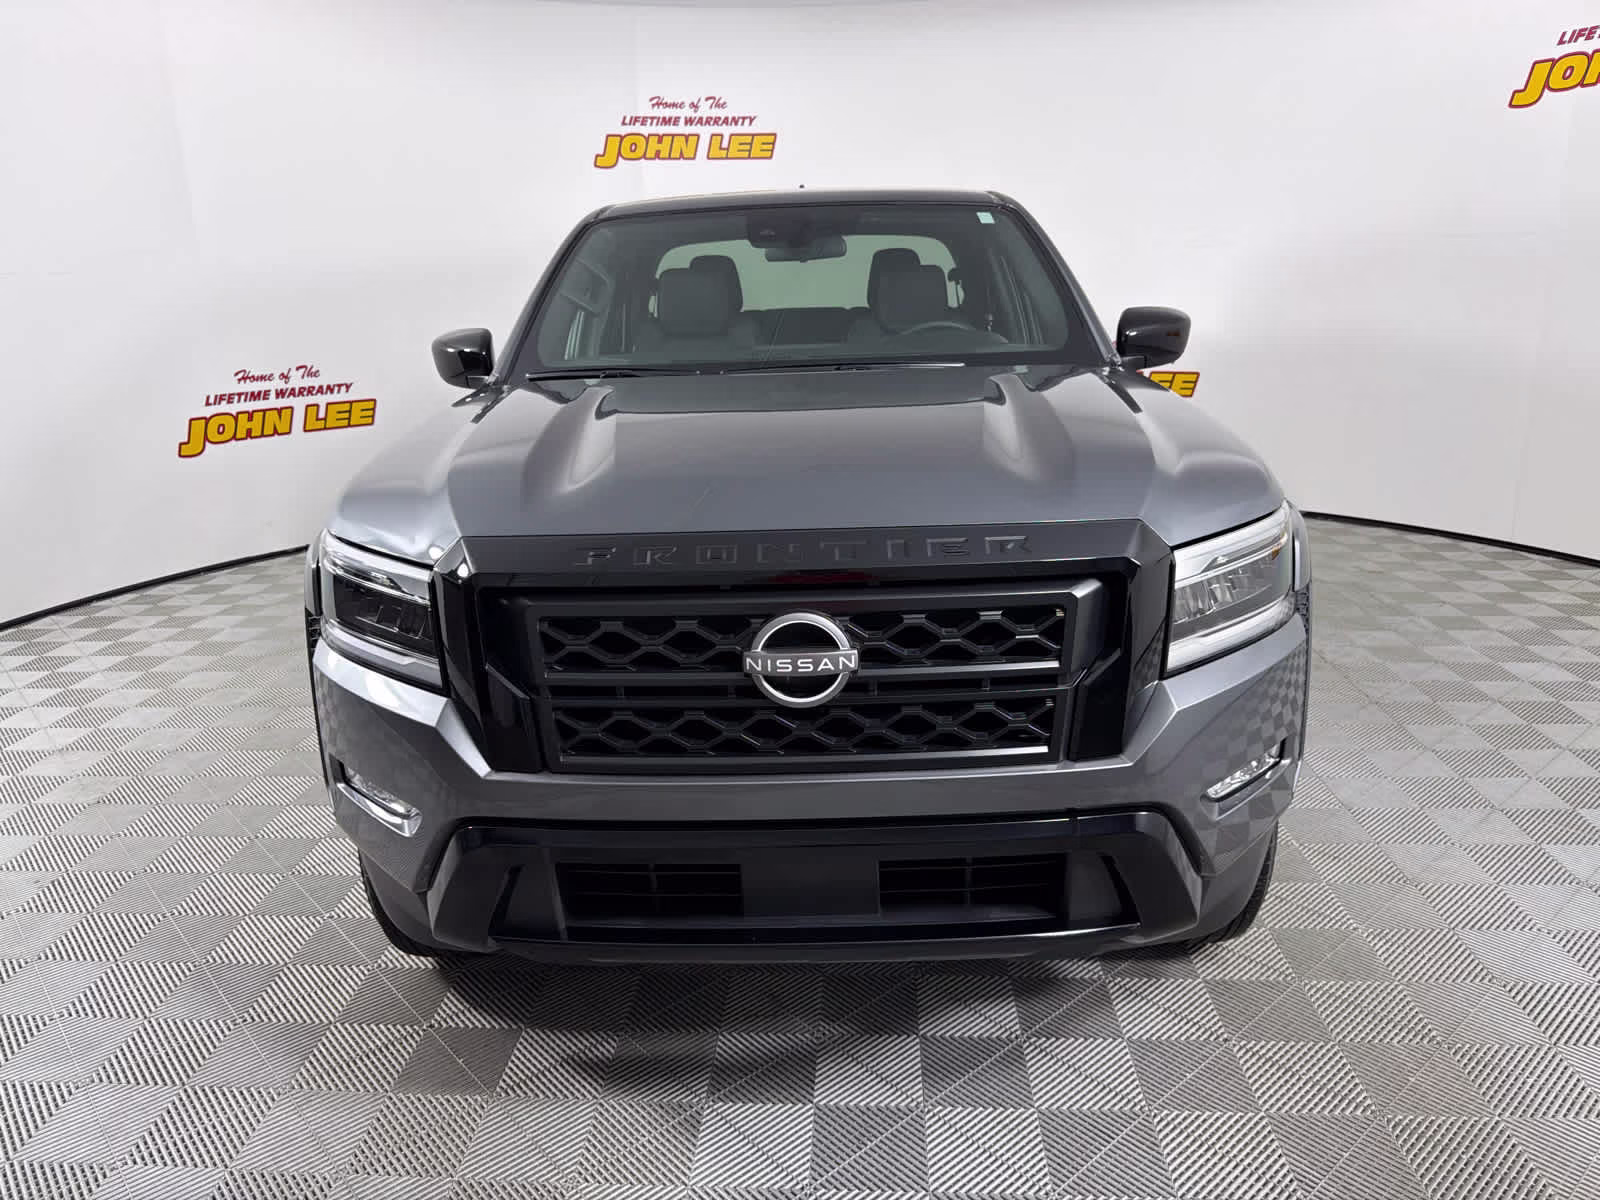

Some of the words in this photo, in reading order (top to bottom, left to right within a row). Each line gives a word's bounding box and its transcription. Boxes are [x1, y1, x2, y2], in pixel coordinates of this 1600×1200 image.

[1556, 25, 1600, 46] LIFE
[649, 96, 685, 110] Home
[689, 97, 700, 113] of
[705, 96, 728, 110] The
[621, 115, 681, 127] LIFETIME
[684, 115, 757, 127] WARRANTY
[594, 133, 700, 169] JOHN
[706, 133, 777, 160] LEE
[233, 369, 274, 384] Home
[278, 368, 292, 383] of
[295, 365, 320, 380] The
[205, 389, 271, 407] LIFETIME
[274, 383, 353, 400] WARRANTY
[178, 406, 294, 458] JOHN
[303, 398, 377, 433] LEE
[574, 534, 1033, 567] FRONTIER
[746, 655, 855, 672] NISSAN
